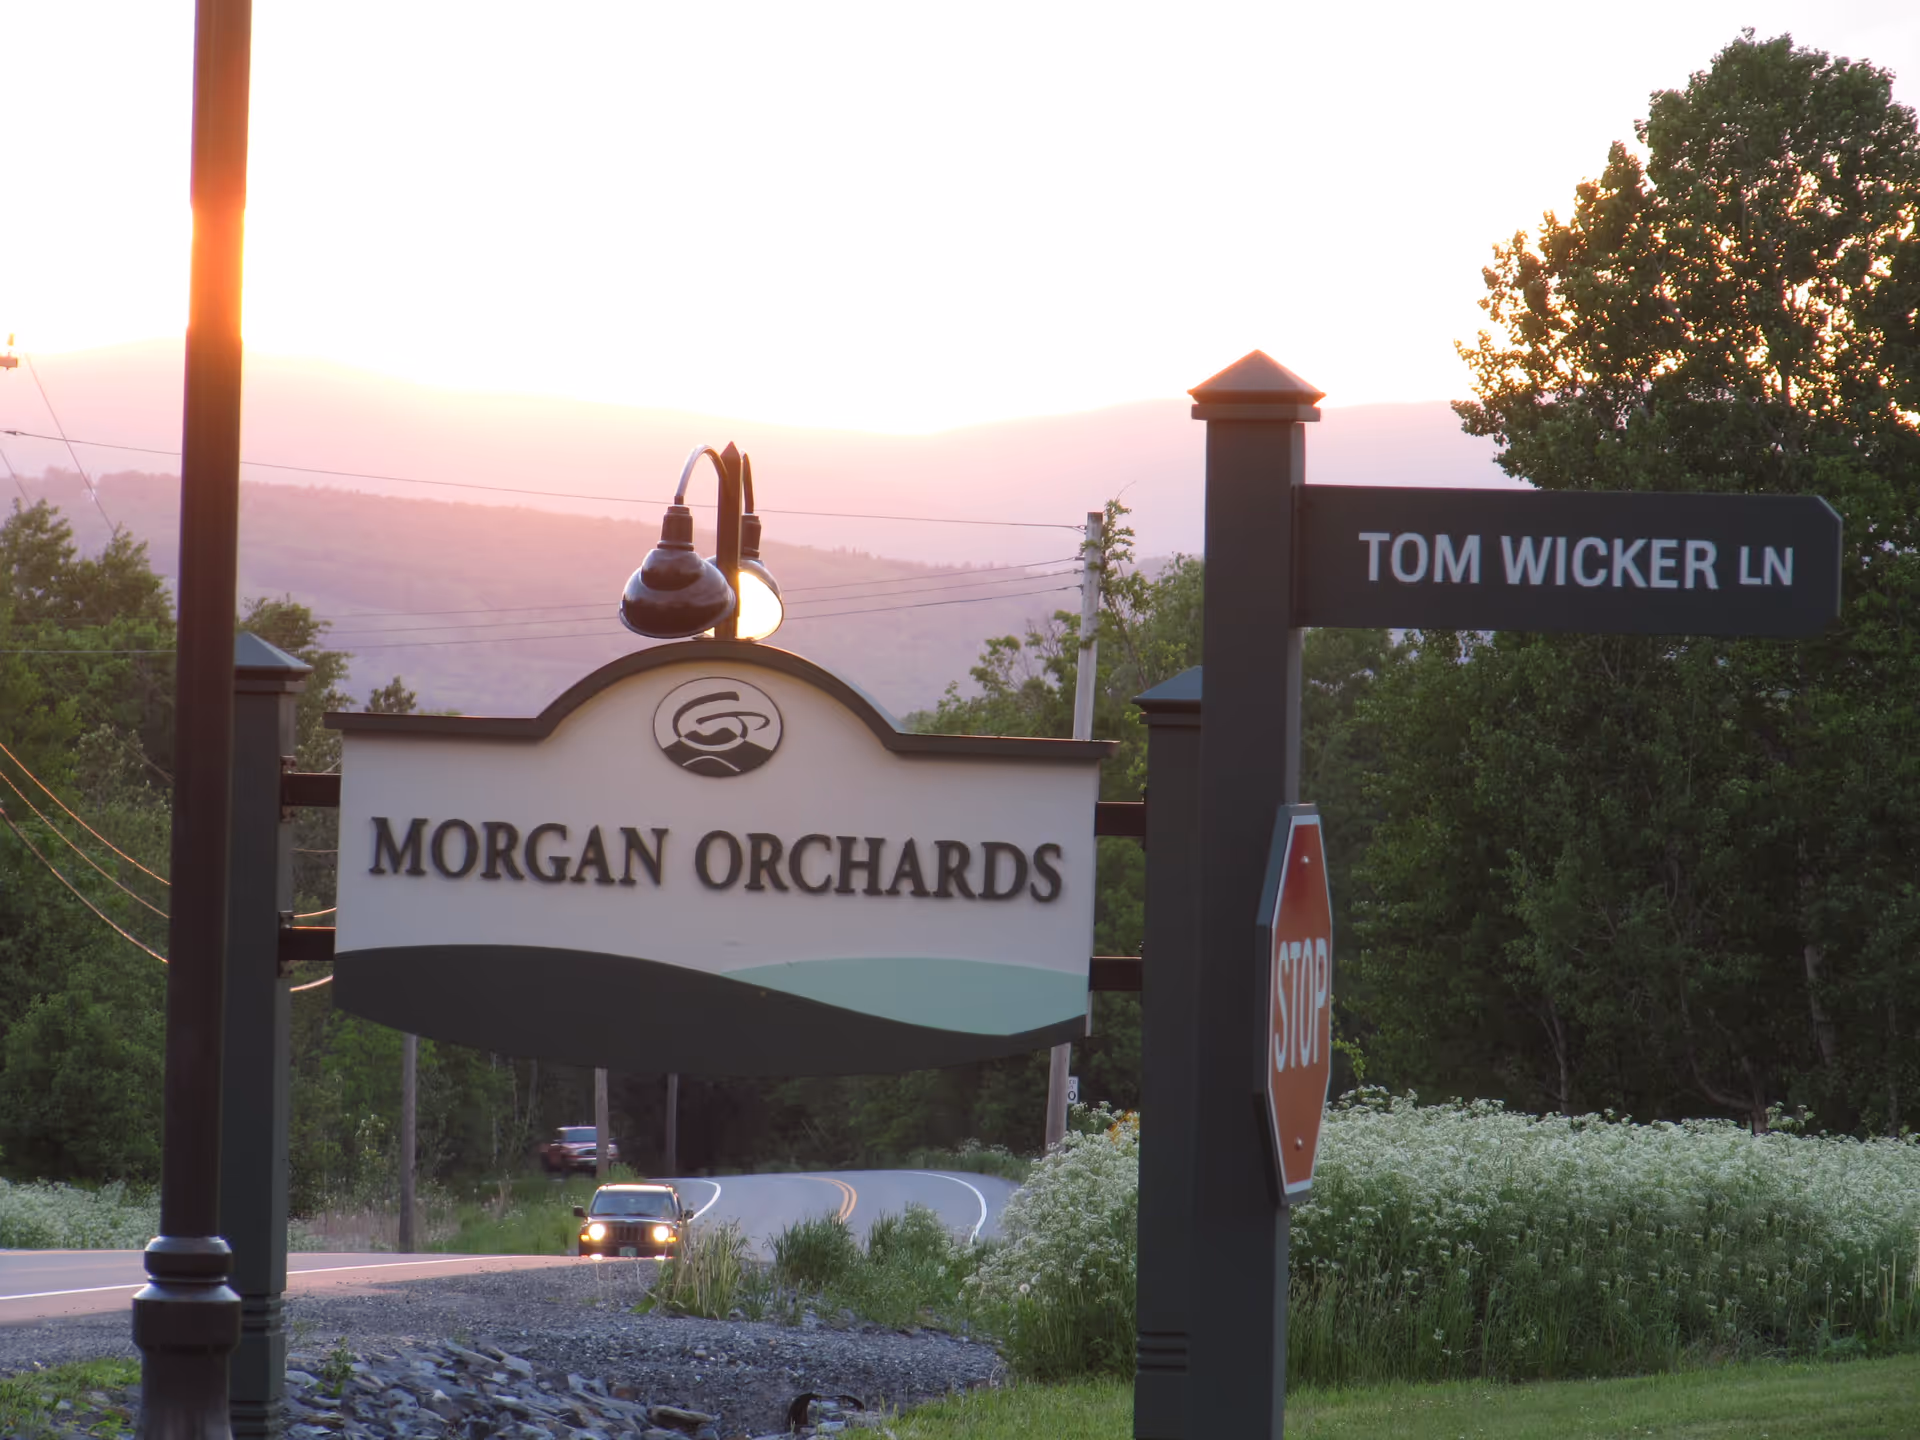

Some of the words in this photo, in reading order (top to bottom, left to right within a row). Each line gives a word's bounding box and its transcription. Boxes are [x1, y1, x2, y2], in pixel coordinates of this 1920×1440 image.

[1358, 532, 1480, 584] TOM
[1501, 535, 1719, 589] WICKER
[1739, 546, 1793, 586] LN
[369, 816, 669, 886] MORGAN
[694, 830, 1063, 902] ORCHARDS
[1274, 937, 1328, 1073] STOP
